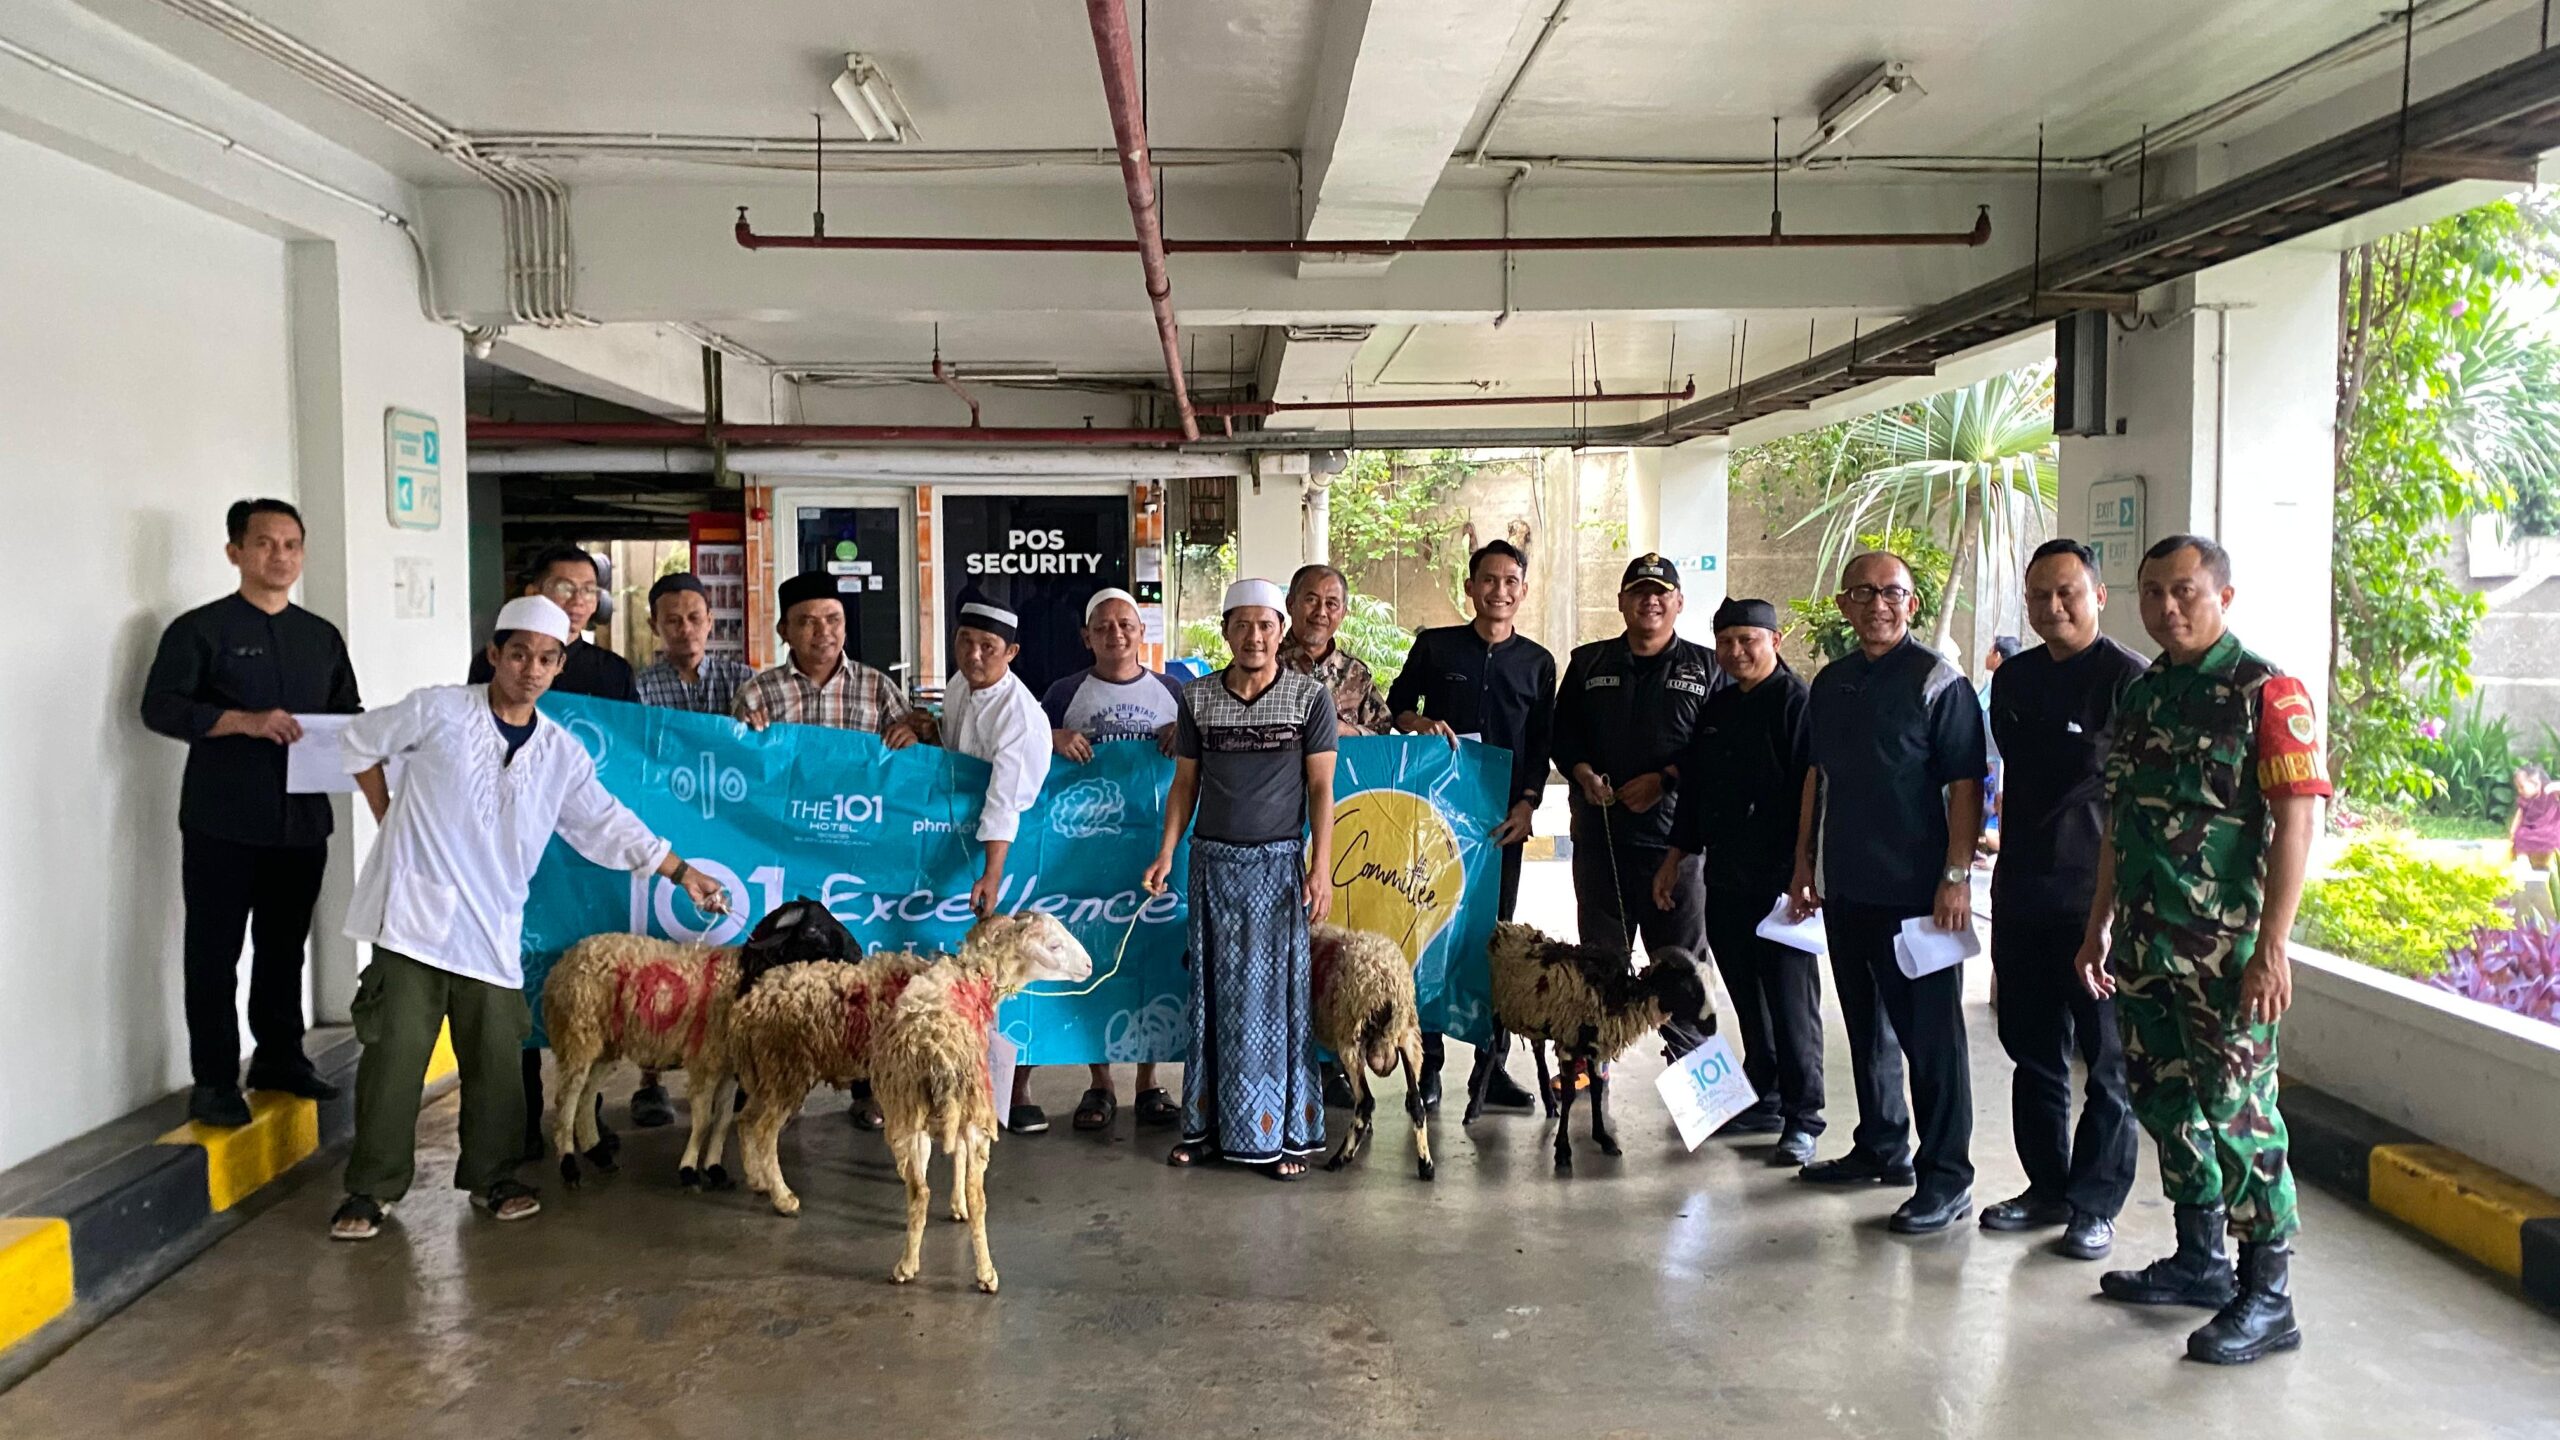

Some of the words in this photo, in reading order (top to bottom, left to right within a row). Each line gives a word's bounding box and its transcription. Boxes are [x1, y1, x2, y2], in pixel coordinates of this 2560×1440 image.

[2096, 501, 2114, 520] EXIT
[1008, 529, 1065, 551] POS
[2109, 543, 2127, 561] EXIT
[966, 553, 1102, 574] SECURITY
[810, 822, 859, 833] HOTEL
[1332, 829, 1438, 911] Committee
[822, 872, 1179, 926] Excellence
[1691, 1051, 1731, 1091] 101
